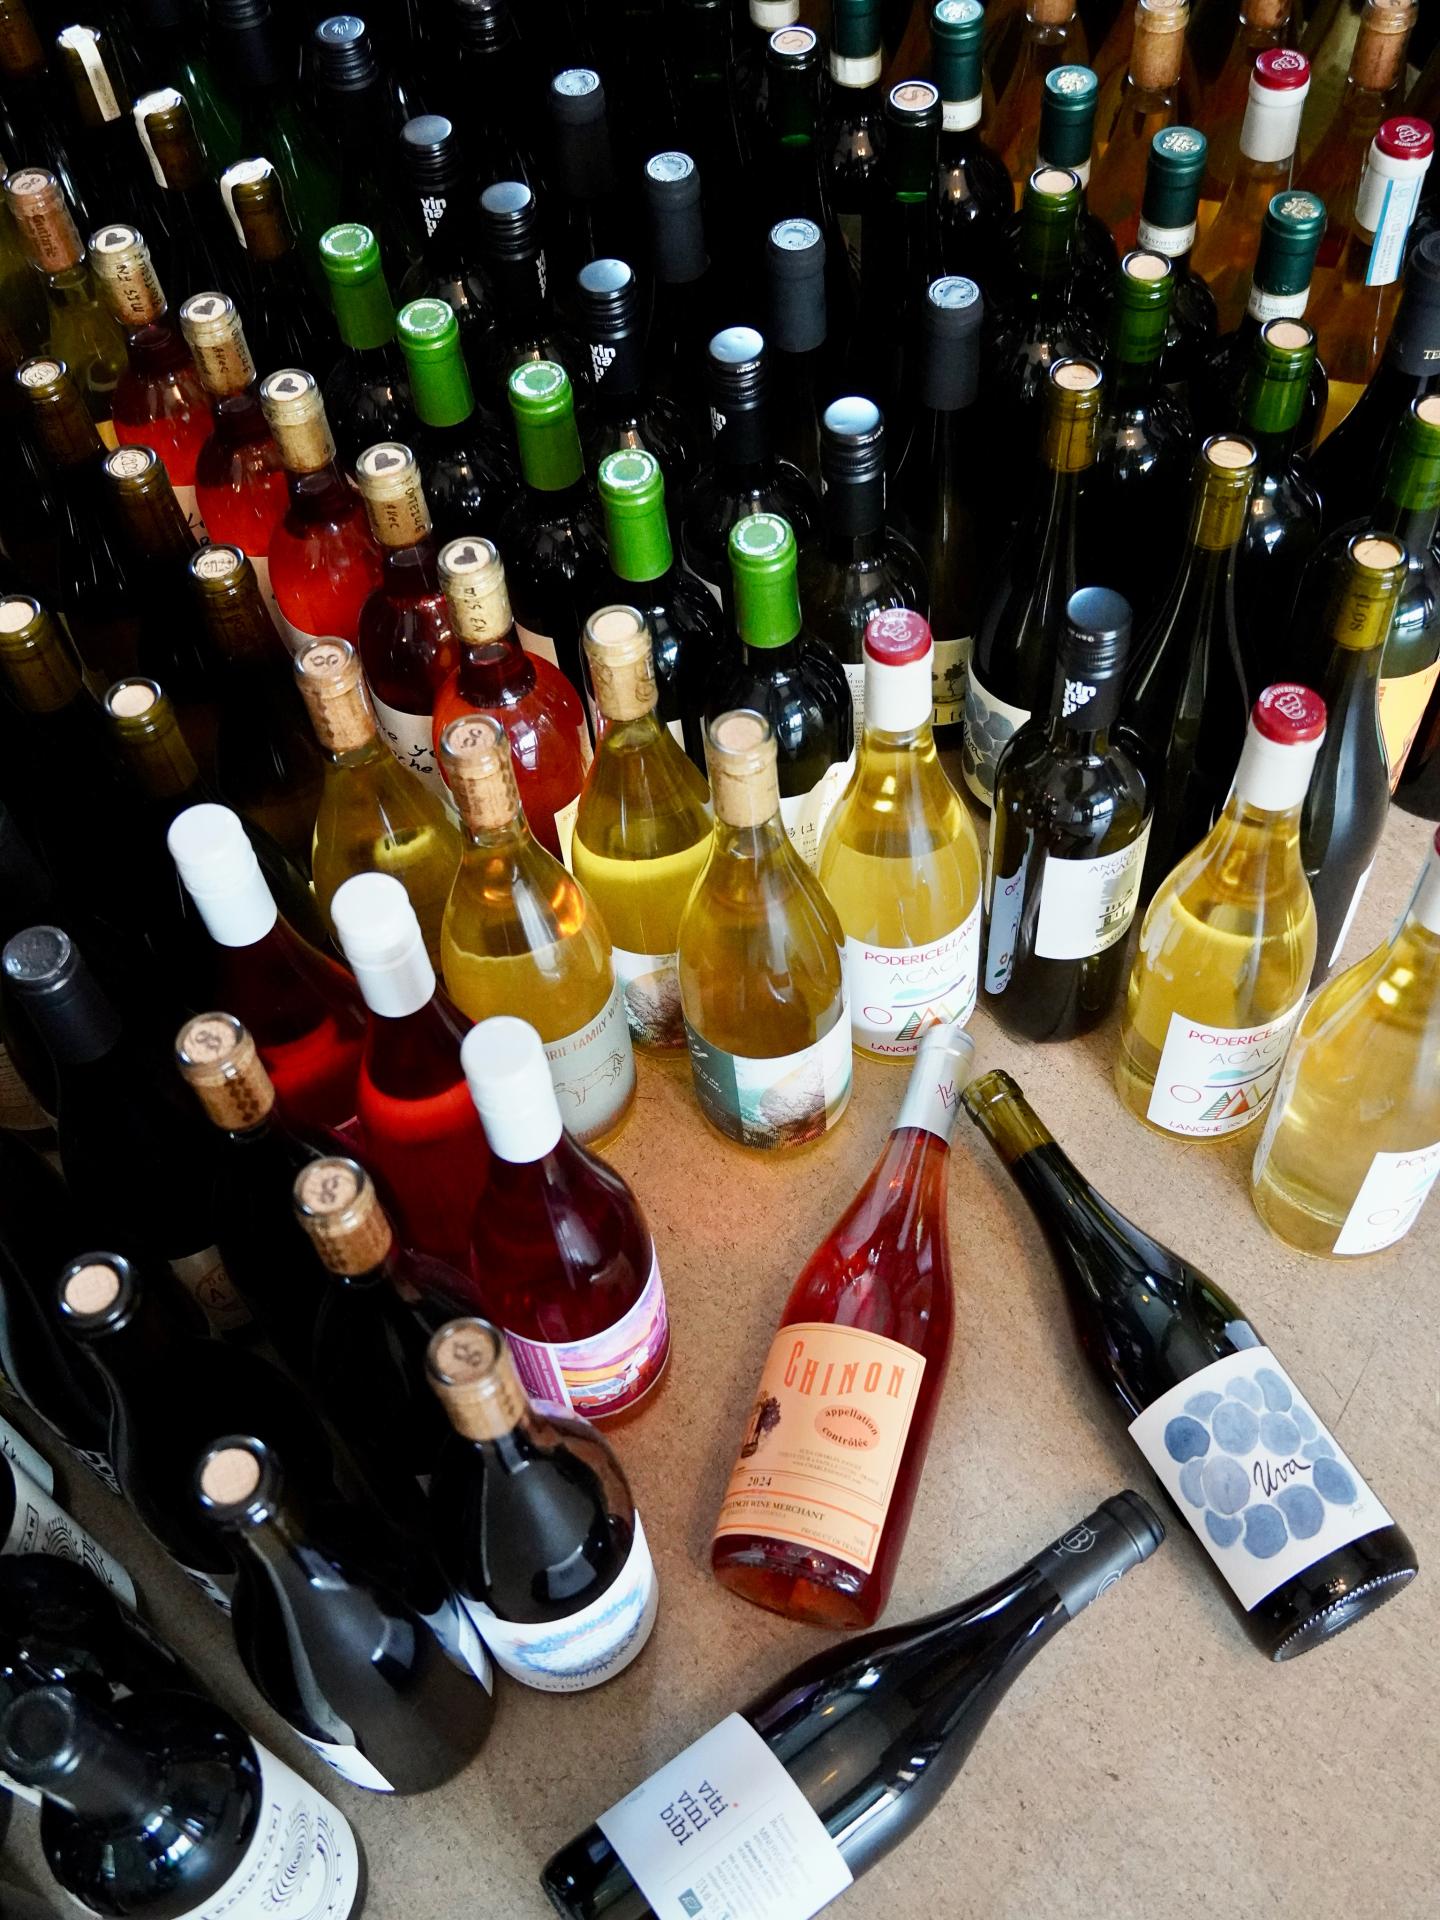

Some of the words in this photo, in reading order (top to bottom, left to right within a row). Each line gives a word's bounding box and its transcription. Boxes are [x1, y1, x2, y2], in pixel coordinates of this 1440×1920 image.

[420, 196, 447, 209] vin
[423, 208, 444, 219] na
[590, 343, 617, 358] vin
[592, 355, 613, 367] na
[1168, 1121, 1222, 1133] LANGHE
[783, 1340, 906, 1399] CHINON
[825, 1408, 878, 1436] appellation
[747, 1476, 773, 1487] 2024
[1253, 1458, 1312, 1497] Uva
[750, 1500, 771, 1509] WINE
[773, 1503, 826, 1521] MERCHANT
[698, 1779, 729, 1818] viti
[677, 1790, 711, 1832] vini
[659, 1803, 694, 1847] bibi
